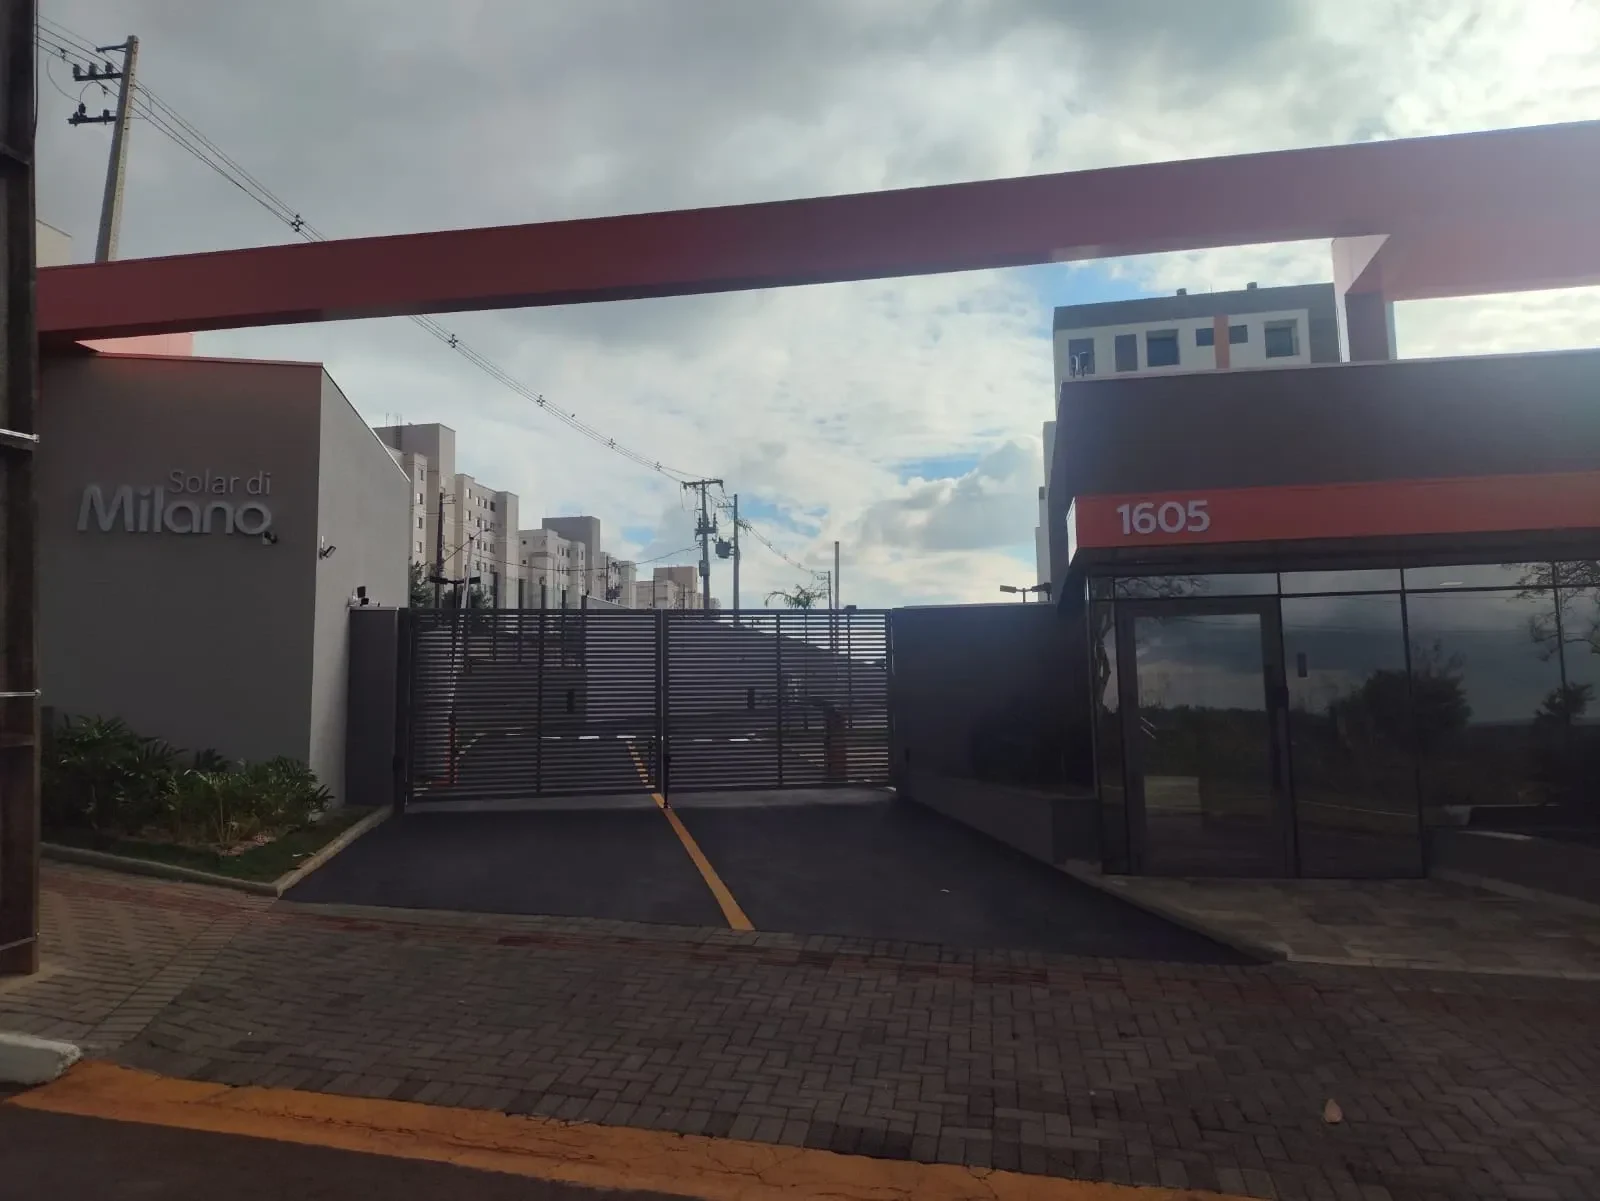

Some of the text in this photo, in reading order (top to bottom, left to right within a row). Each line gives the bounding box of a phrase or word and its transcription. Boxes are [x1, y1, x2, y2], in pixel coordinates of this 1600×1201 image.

[168, 468, 271, 495] Solar di
[76, 484, 273, 535] Milano
[1116, 500, 1211, 535] 1605
